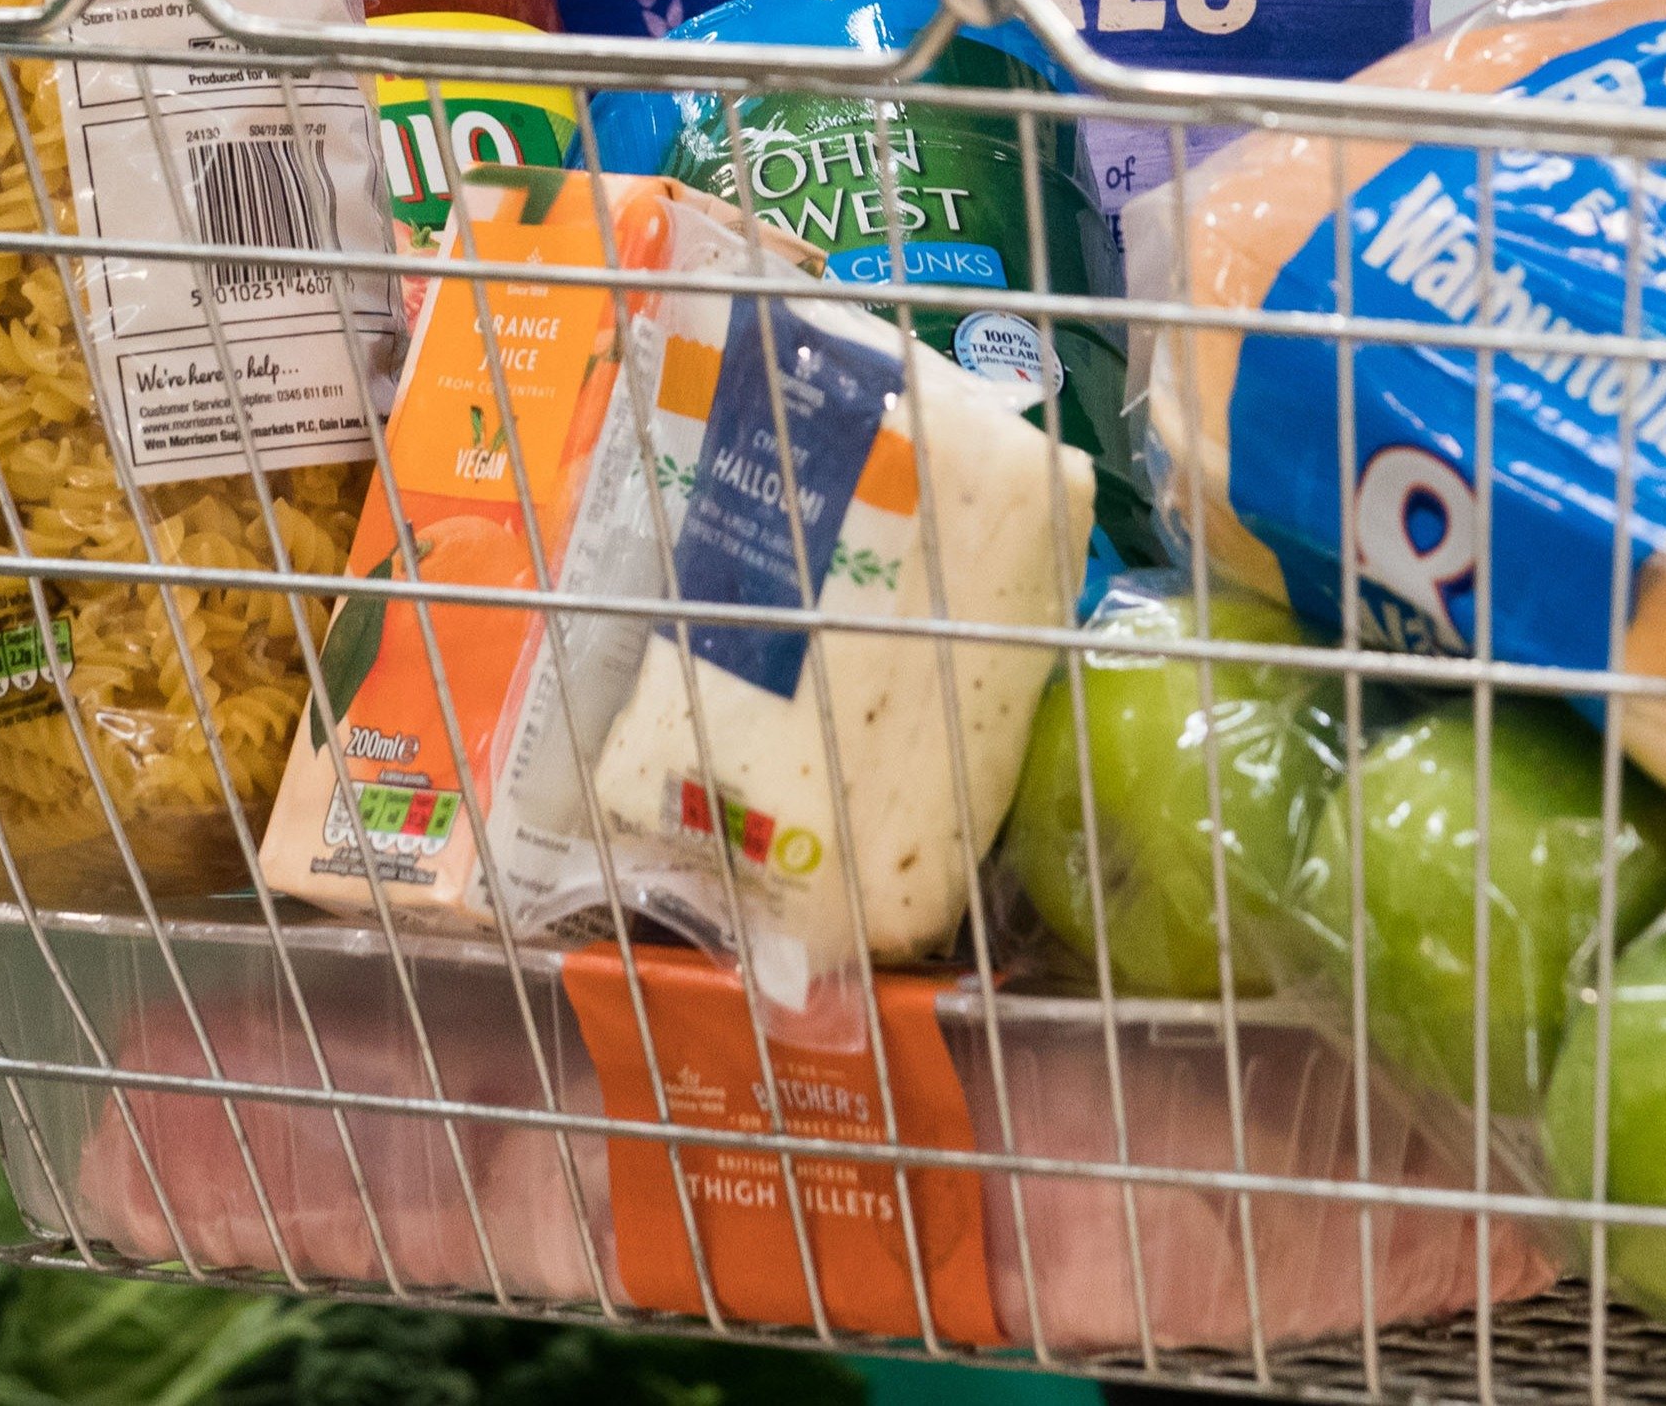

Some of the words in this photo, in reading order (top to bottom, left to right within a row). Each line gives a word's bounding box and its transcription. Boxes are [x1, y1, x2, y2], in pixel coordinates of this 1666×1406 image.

[83, 12, 114, 26] Store
[131, 9, 138, 20] a
[141, 4, 163, 18] cool
[166, 2, 183, 17] dry
[188, 71, 245, 86] Produced
[247, 69, 264, 80] for
[751, 128, 921, 199] OHN
[1106, 155, 1136, 192] of
[754, 186, 970, 242] WEST
[851, 251, 993, 281] CHUNKS
[191, 289, 203, 307] 5
[215, 281, 285, 305] 010251
[972, 344, 1041, 362] TRACEABL
[984, 330, 1031, 349] 100%
[136, 363, 186, 393] We're
[189, 362, 224, 386] here
[977, 355, 1042, 372] john-west.co
[140, 403, 189, 418] Customer
[241, 392, 273, 407] elpline:
[277, 388, 301, 402] 0345
[303, 387, 320, 400] 611
[322, 384, 344, 398] 6111
[437, 375, 474, 392] FROM
[477, 381, 558, 399] COENTRATE
[144, 438, 167, 451] Wm
[169, 433, 218, 447] Morrison
[220, 422, 295, 442] Supmarkets
[296, 420, 318, 433] PLC,
[319, 417, 339, 431] Gain
[454, 447, 508, 481] VEGAN
[346, 727, 401, 761] 200ml
[752, 1080, 870, 1123] BTCHER'S
[795, 1163, 858, 1183] HICKEN
[686, 1173, 777, 1208] THIGH
[805, 1186, 894, 1222] ILLETS
